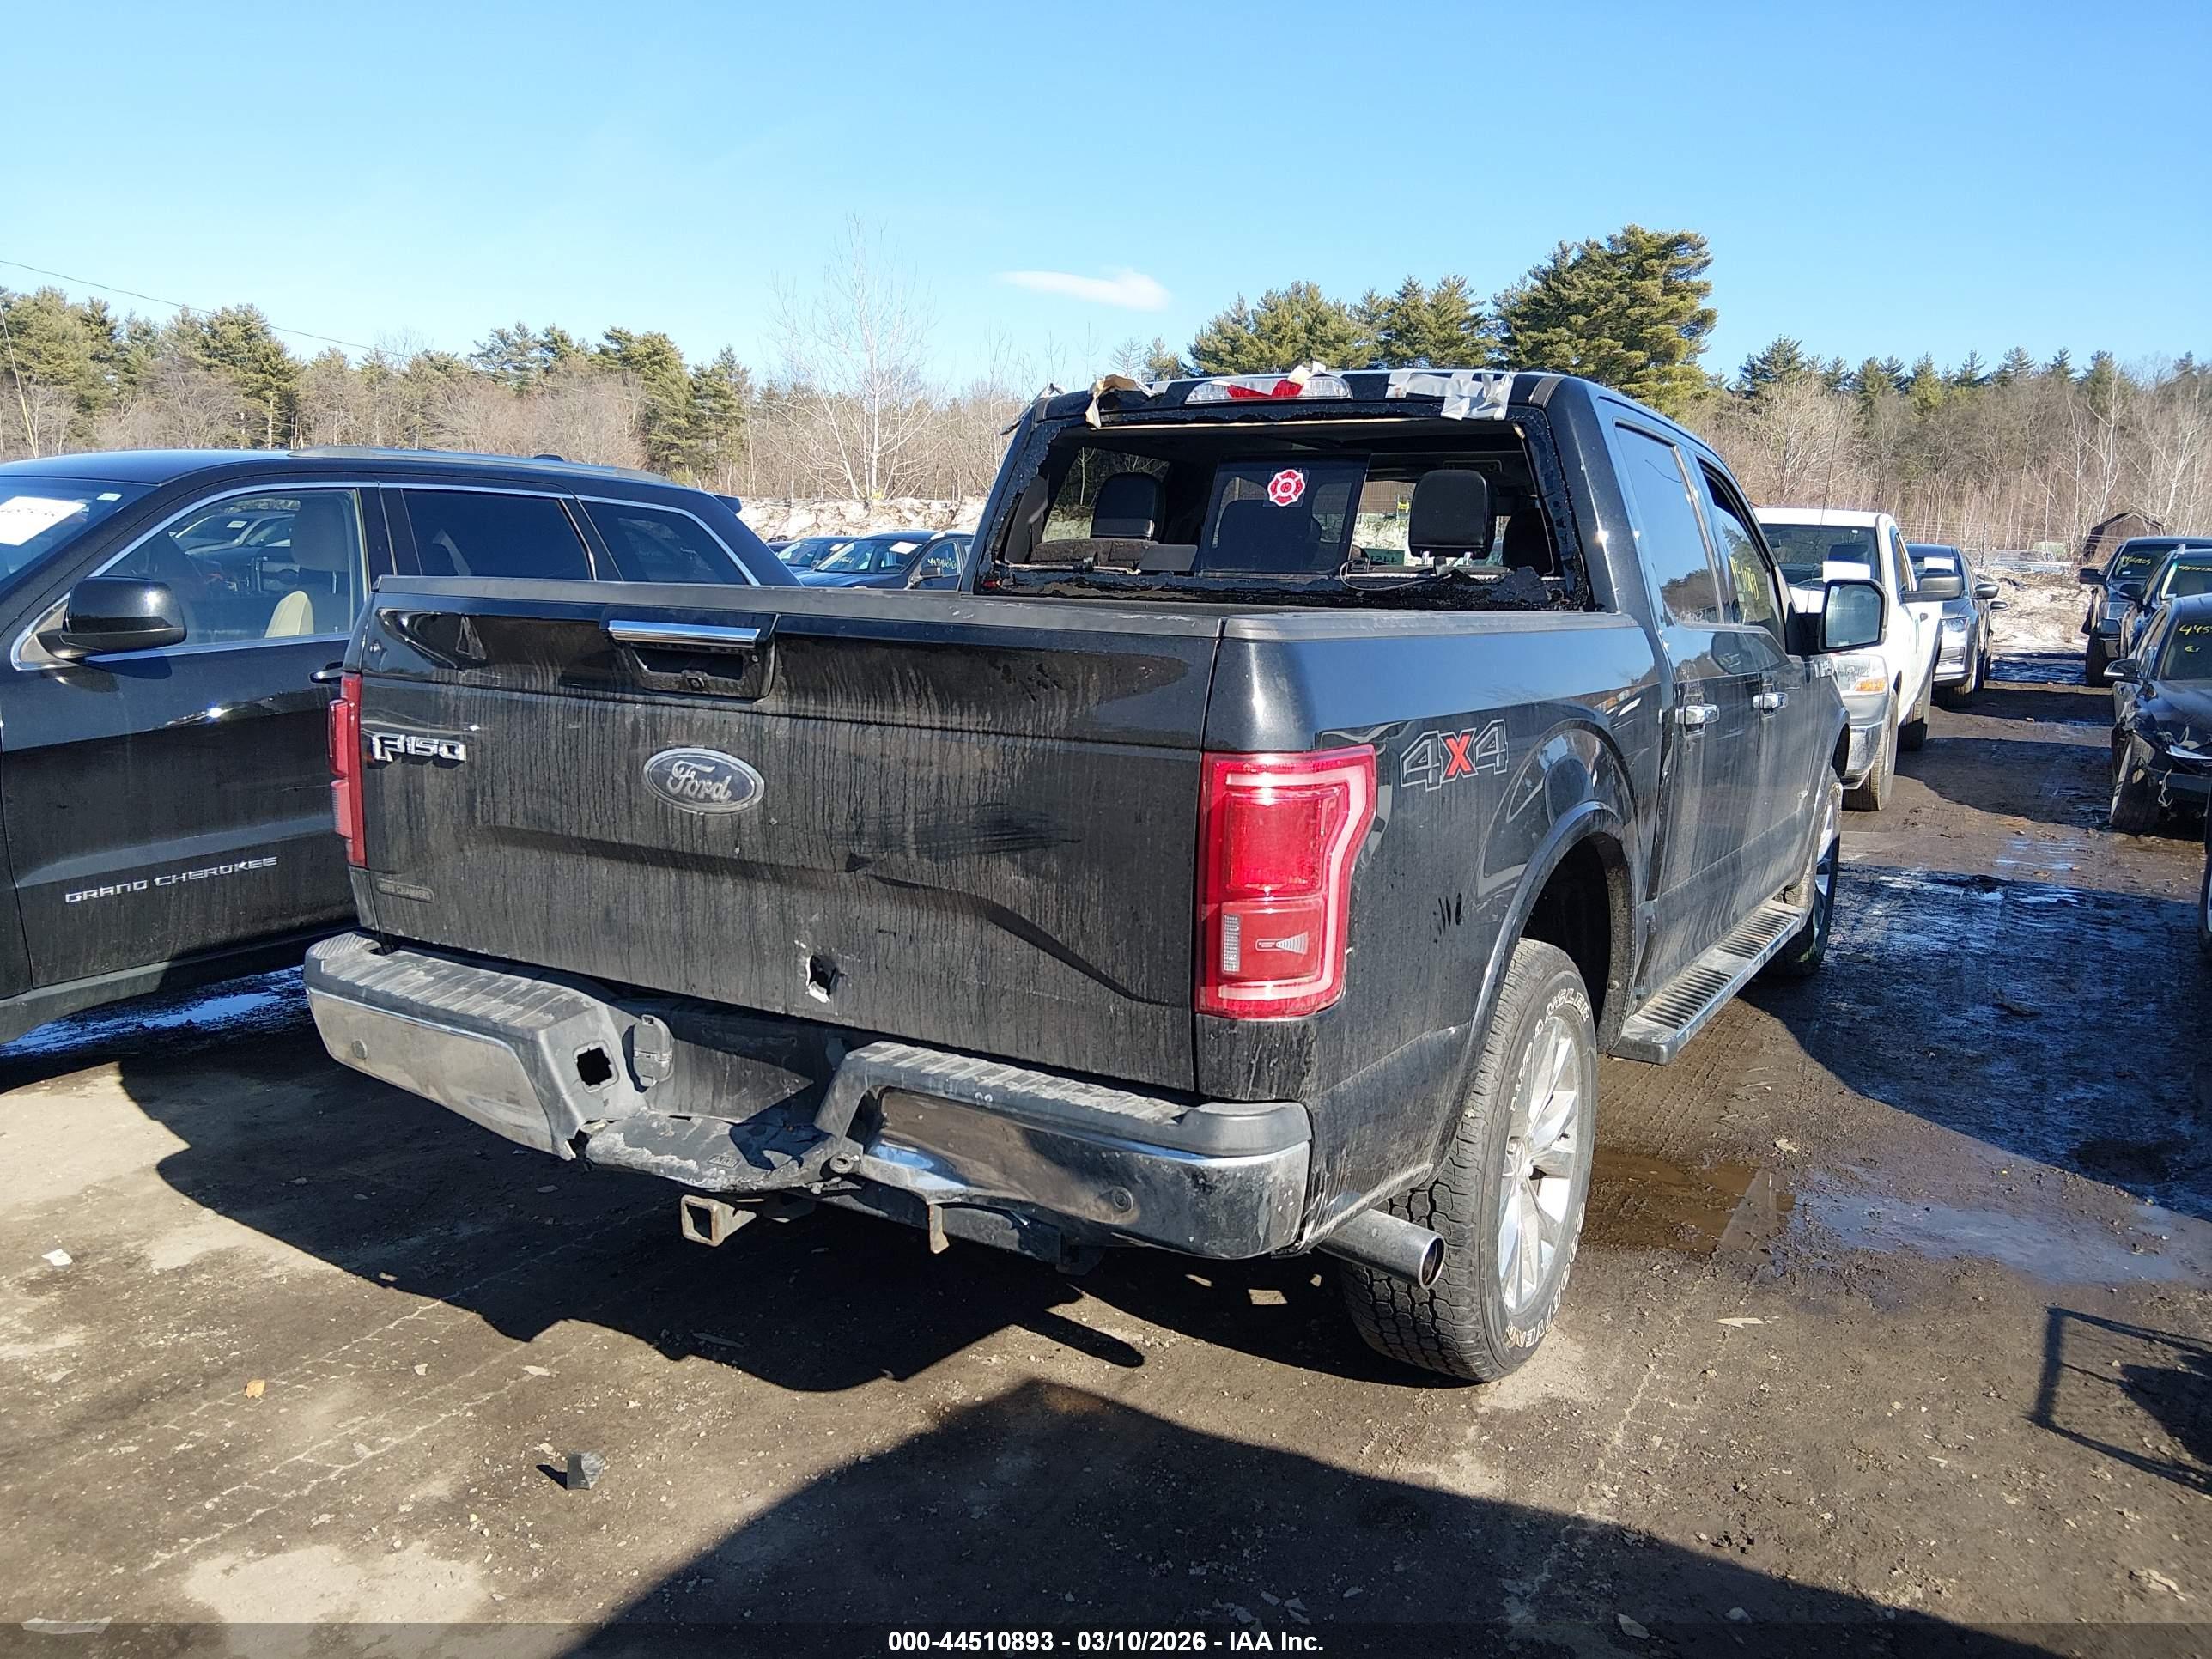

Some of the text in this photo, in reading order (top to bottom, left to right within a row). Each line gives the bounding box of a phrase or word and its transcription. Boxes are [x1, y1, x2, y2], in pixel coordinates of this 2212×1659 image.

[667, 760, 732, 801] Ford
[65, 856, 278, 902] GRAND CHEROKEE
